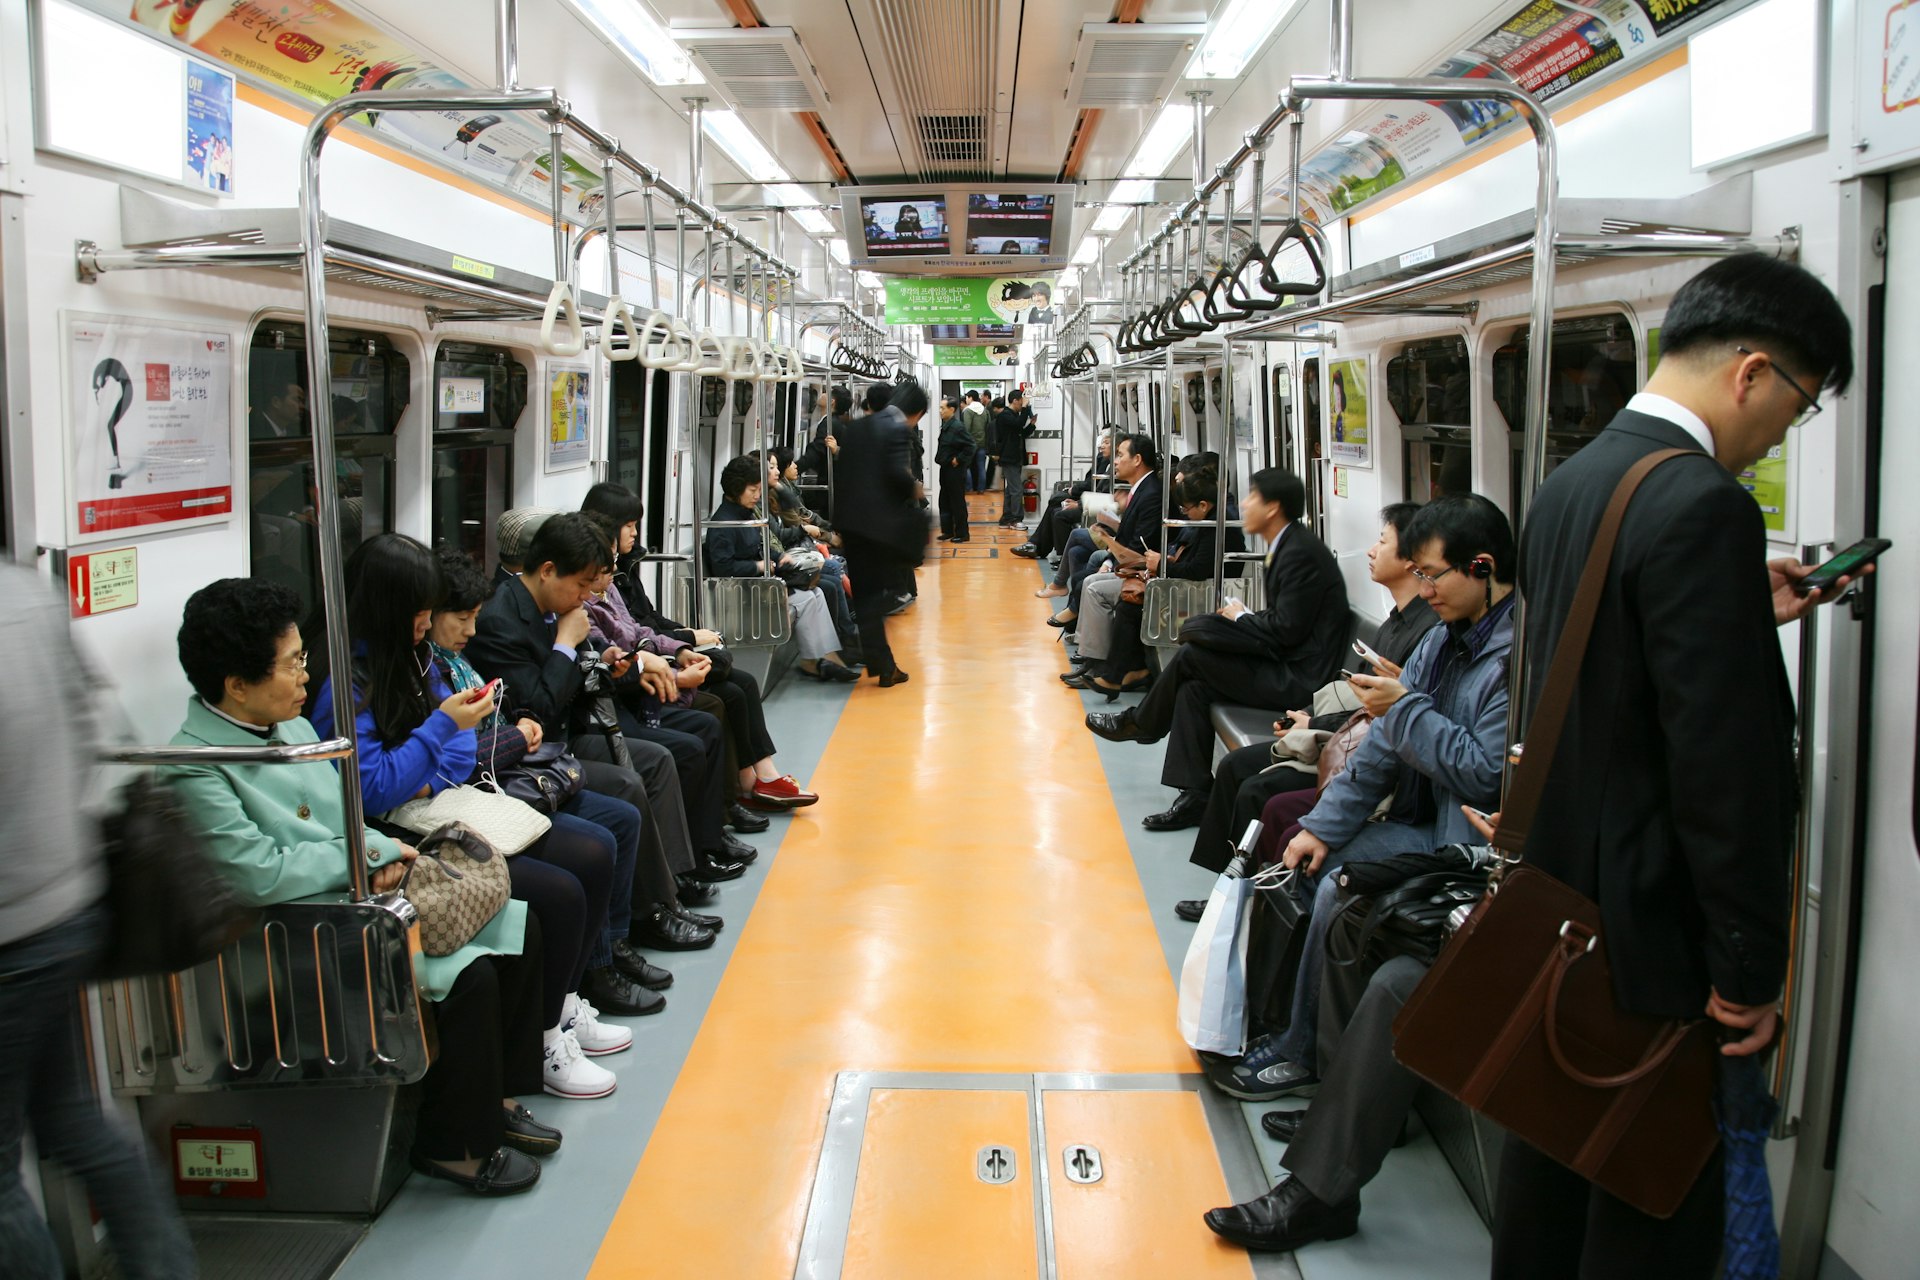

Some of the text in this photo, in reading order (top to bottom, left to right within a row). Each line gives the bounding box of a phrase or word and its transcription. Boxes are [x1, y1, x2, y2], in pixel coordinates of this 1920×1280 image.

[900, 287, 971, 296] 생각의 프레임을 바꾸면,
[908, 295, 963, 304] 시프트가 보입니다
[188, 1166, 249, 1177] 출입문 비상콕크
